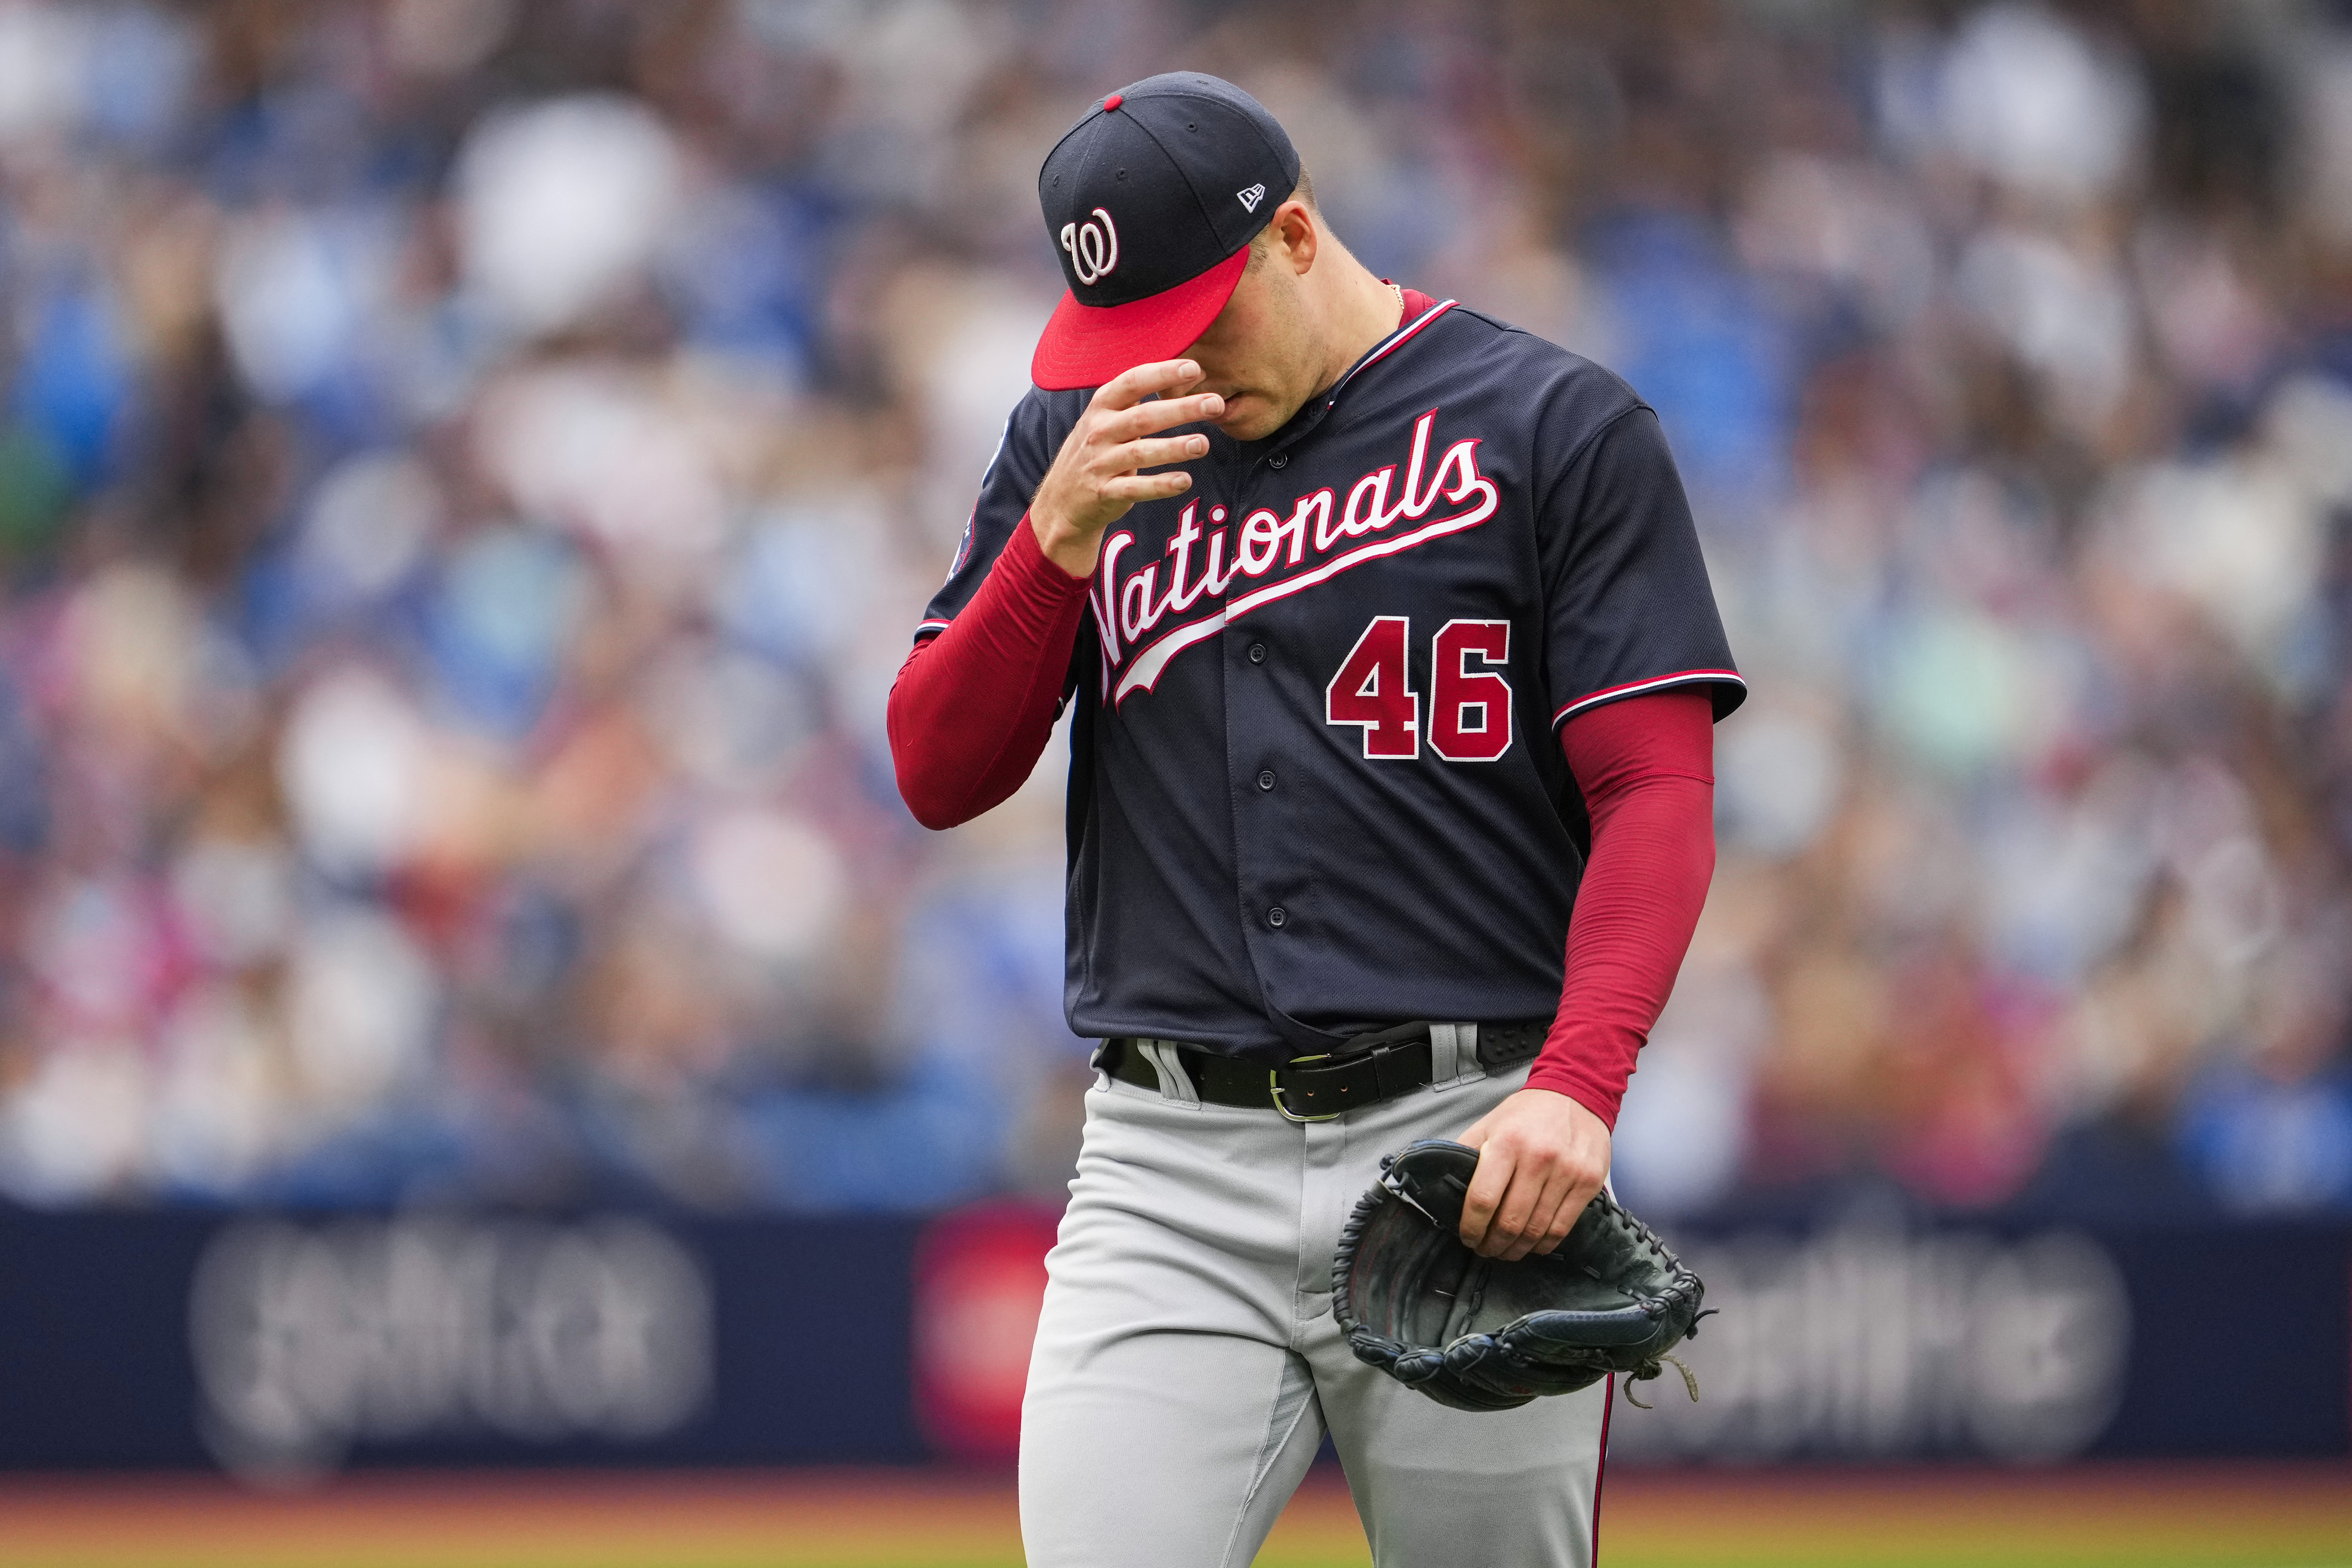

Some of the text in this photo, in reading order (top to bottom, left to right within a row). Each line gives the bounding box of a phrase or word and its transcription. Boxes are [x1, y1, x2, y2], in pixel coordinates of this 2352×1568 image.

[1061, 207, 1119, 286] W
[1090, 407, 1501, 709] Nationals
[1326, 616, 1513, 762] 46
